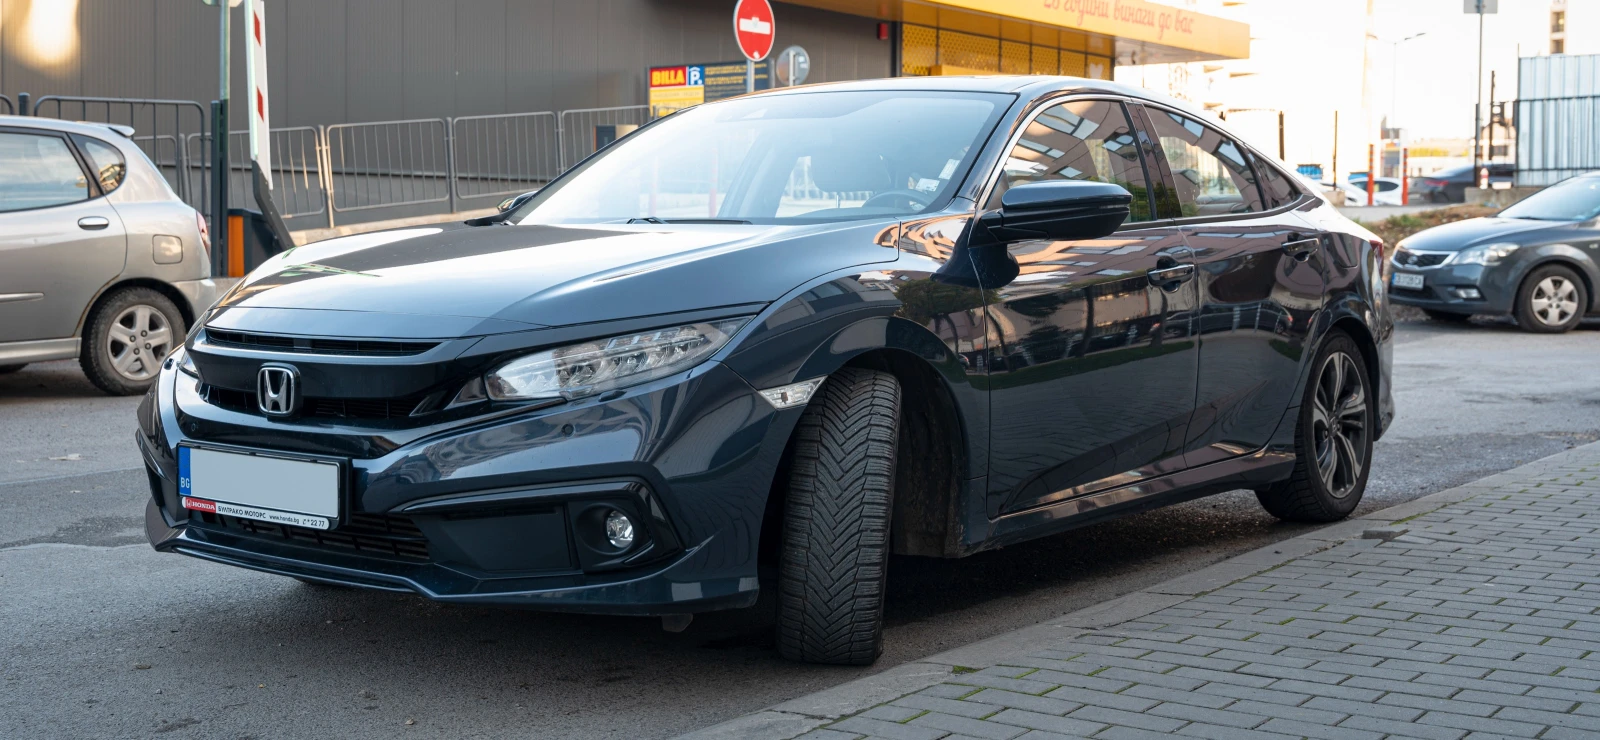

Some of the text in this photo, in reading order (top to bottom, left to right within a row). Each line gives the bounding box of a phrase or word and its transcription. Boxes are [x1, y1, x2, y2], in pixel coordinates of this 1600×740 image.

[1158, 12, 1171, 40] до
[651, 69, 685, 86] BILLA
[180, 477, 190, 489] BG
[192, 501, 216, 511] HONDA
